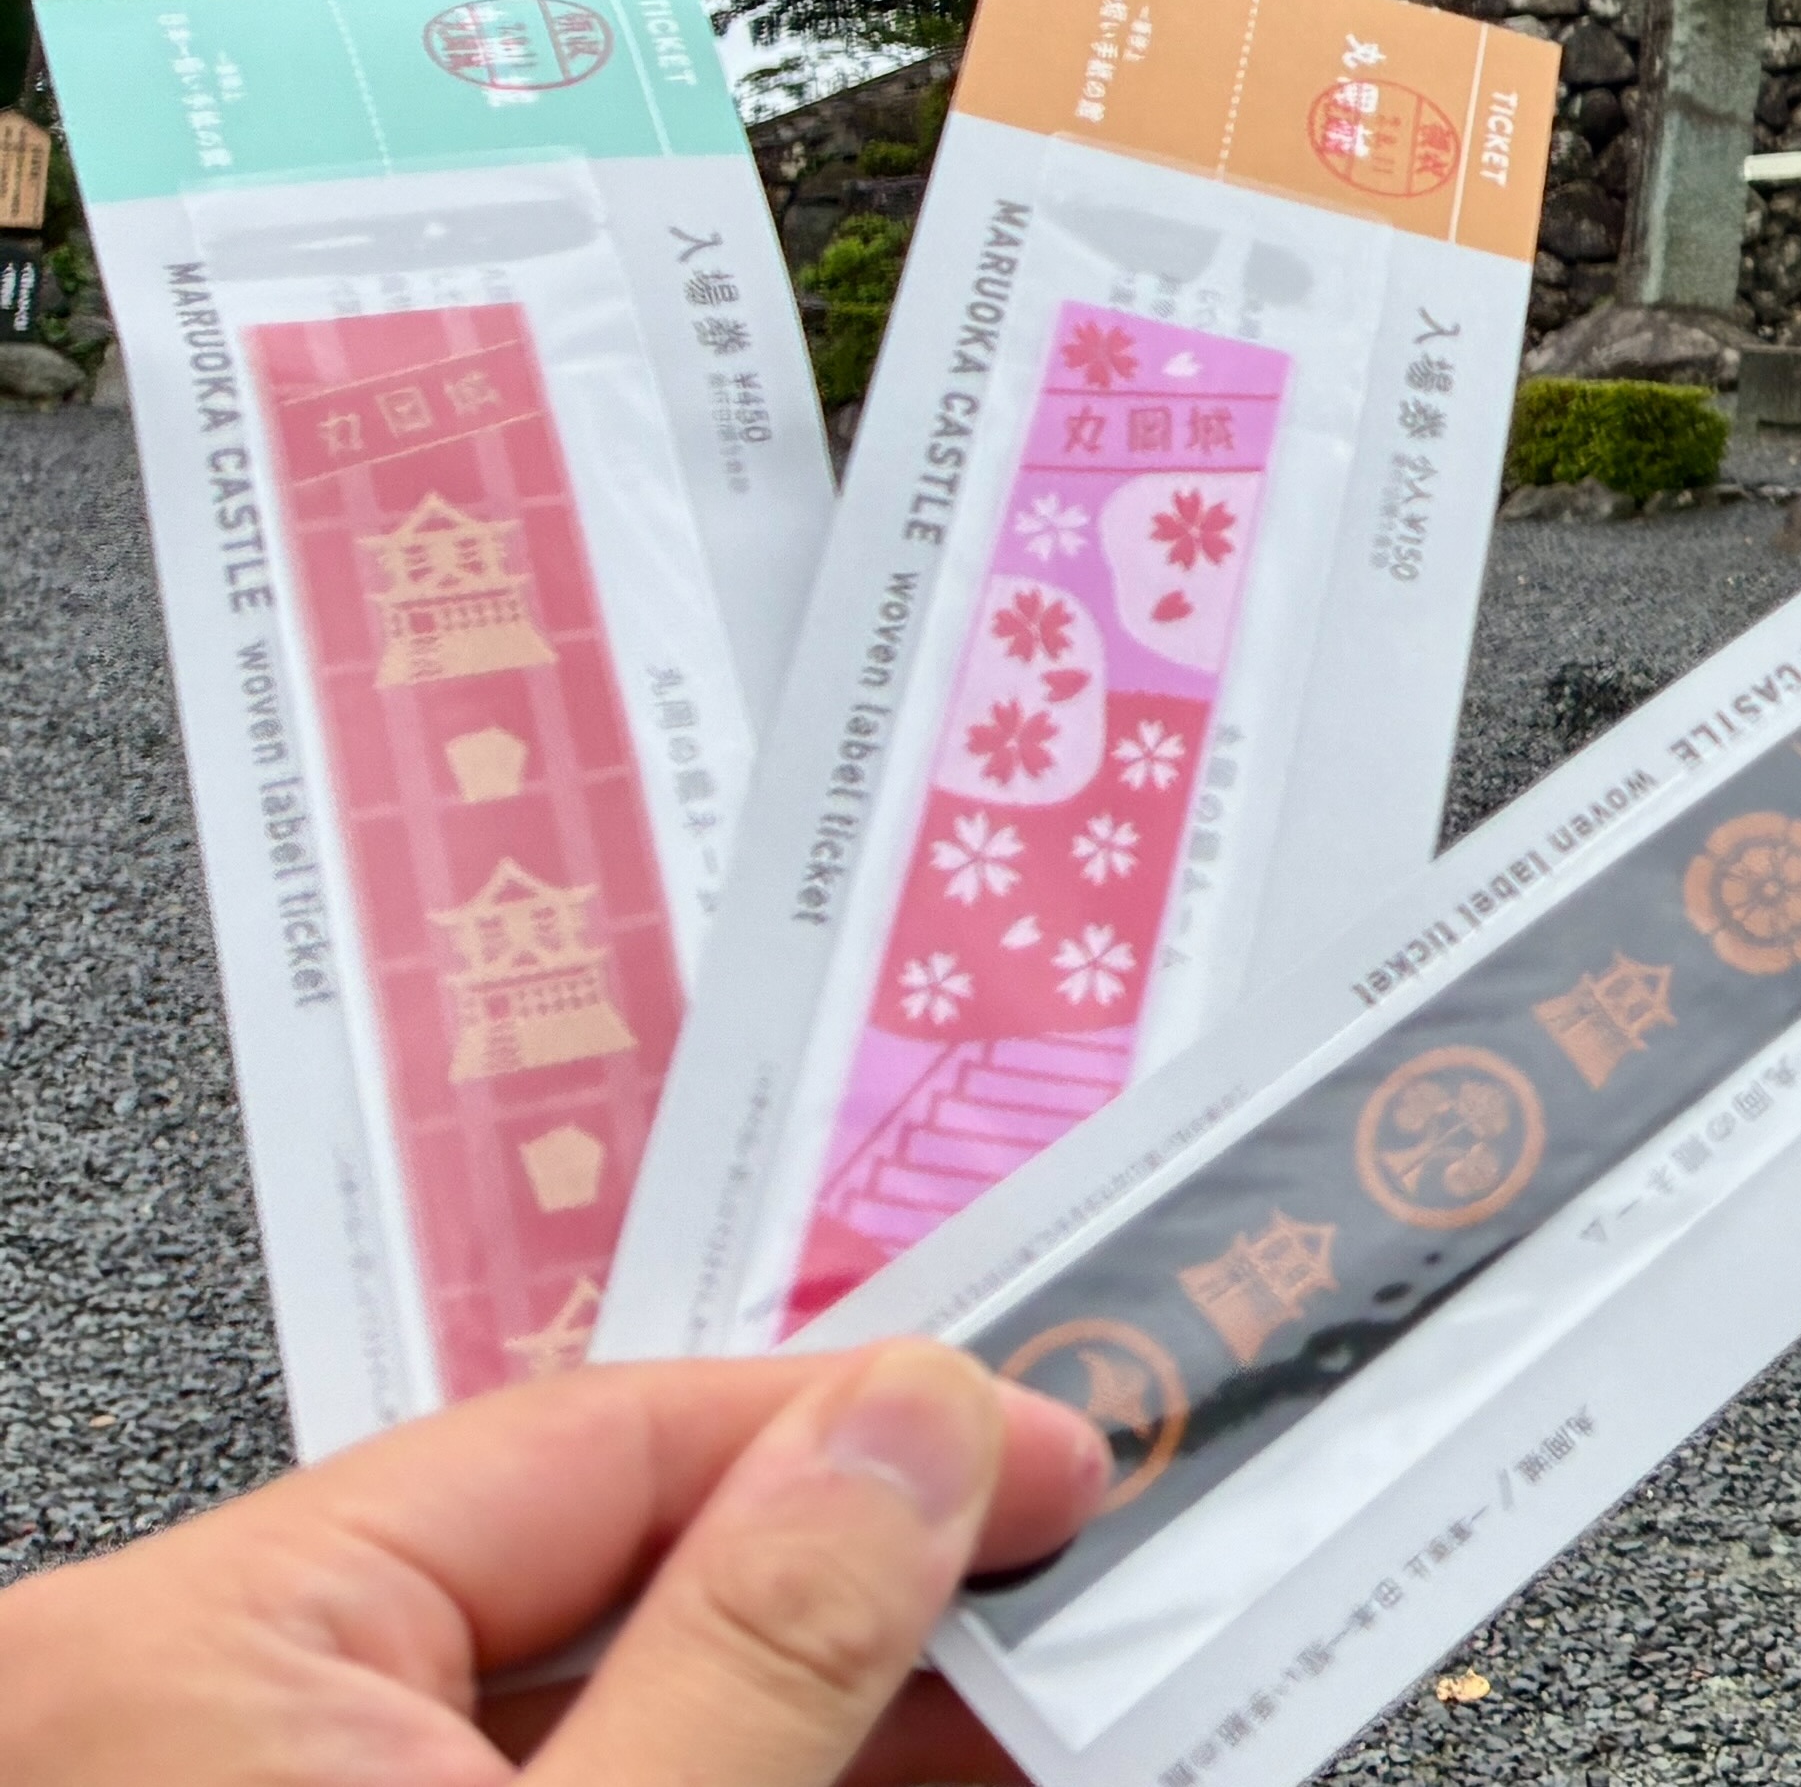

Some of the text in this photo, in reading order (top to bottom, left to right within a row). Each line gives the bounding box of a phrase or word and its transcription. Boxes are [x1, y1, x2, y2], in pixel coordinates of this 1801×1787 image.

[1479, 90, 1520, 188] TICKET
[668, 215, 775, 447] 入場券 ¥450
[1397, 308, 1463, 442] 入場券
[1067, 405, 1239, 460] 丸岡城
[791, 199, 1031, 929] MARUOKA CASTLE woven label ticket
[164, 258, 336, 1009] MARUOKA CASTLE woven label ticket
[1547, 764, 1656, 860] woven
[1454, 847, 1553, 934] label
[1348, 918, 1460, 1013] ticket
